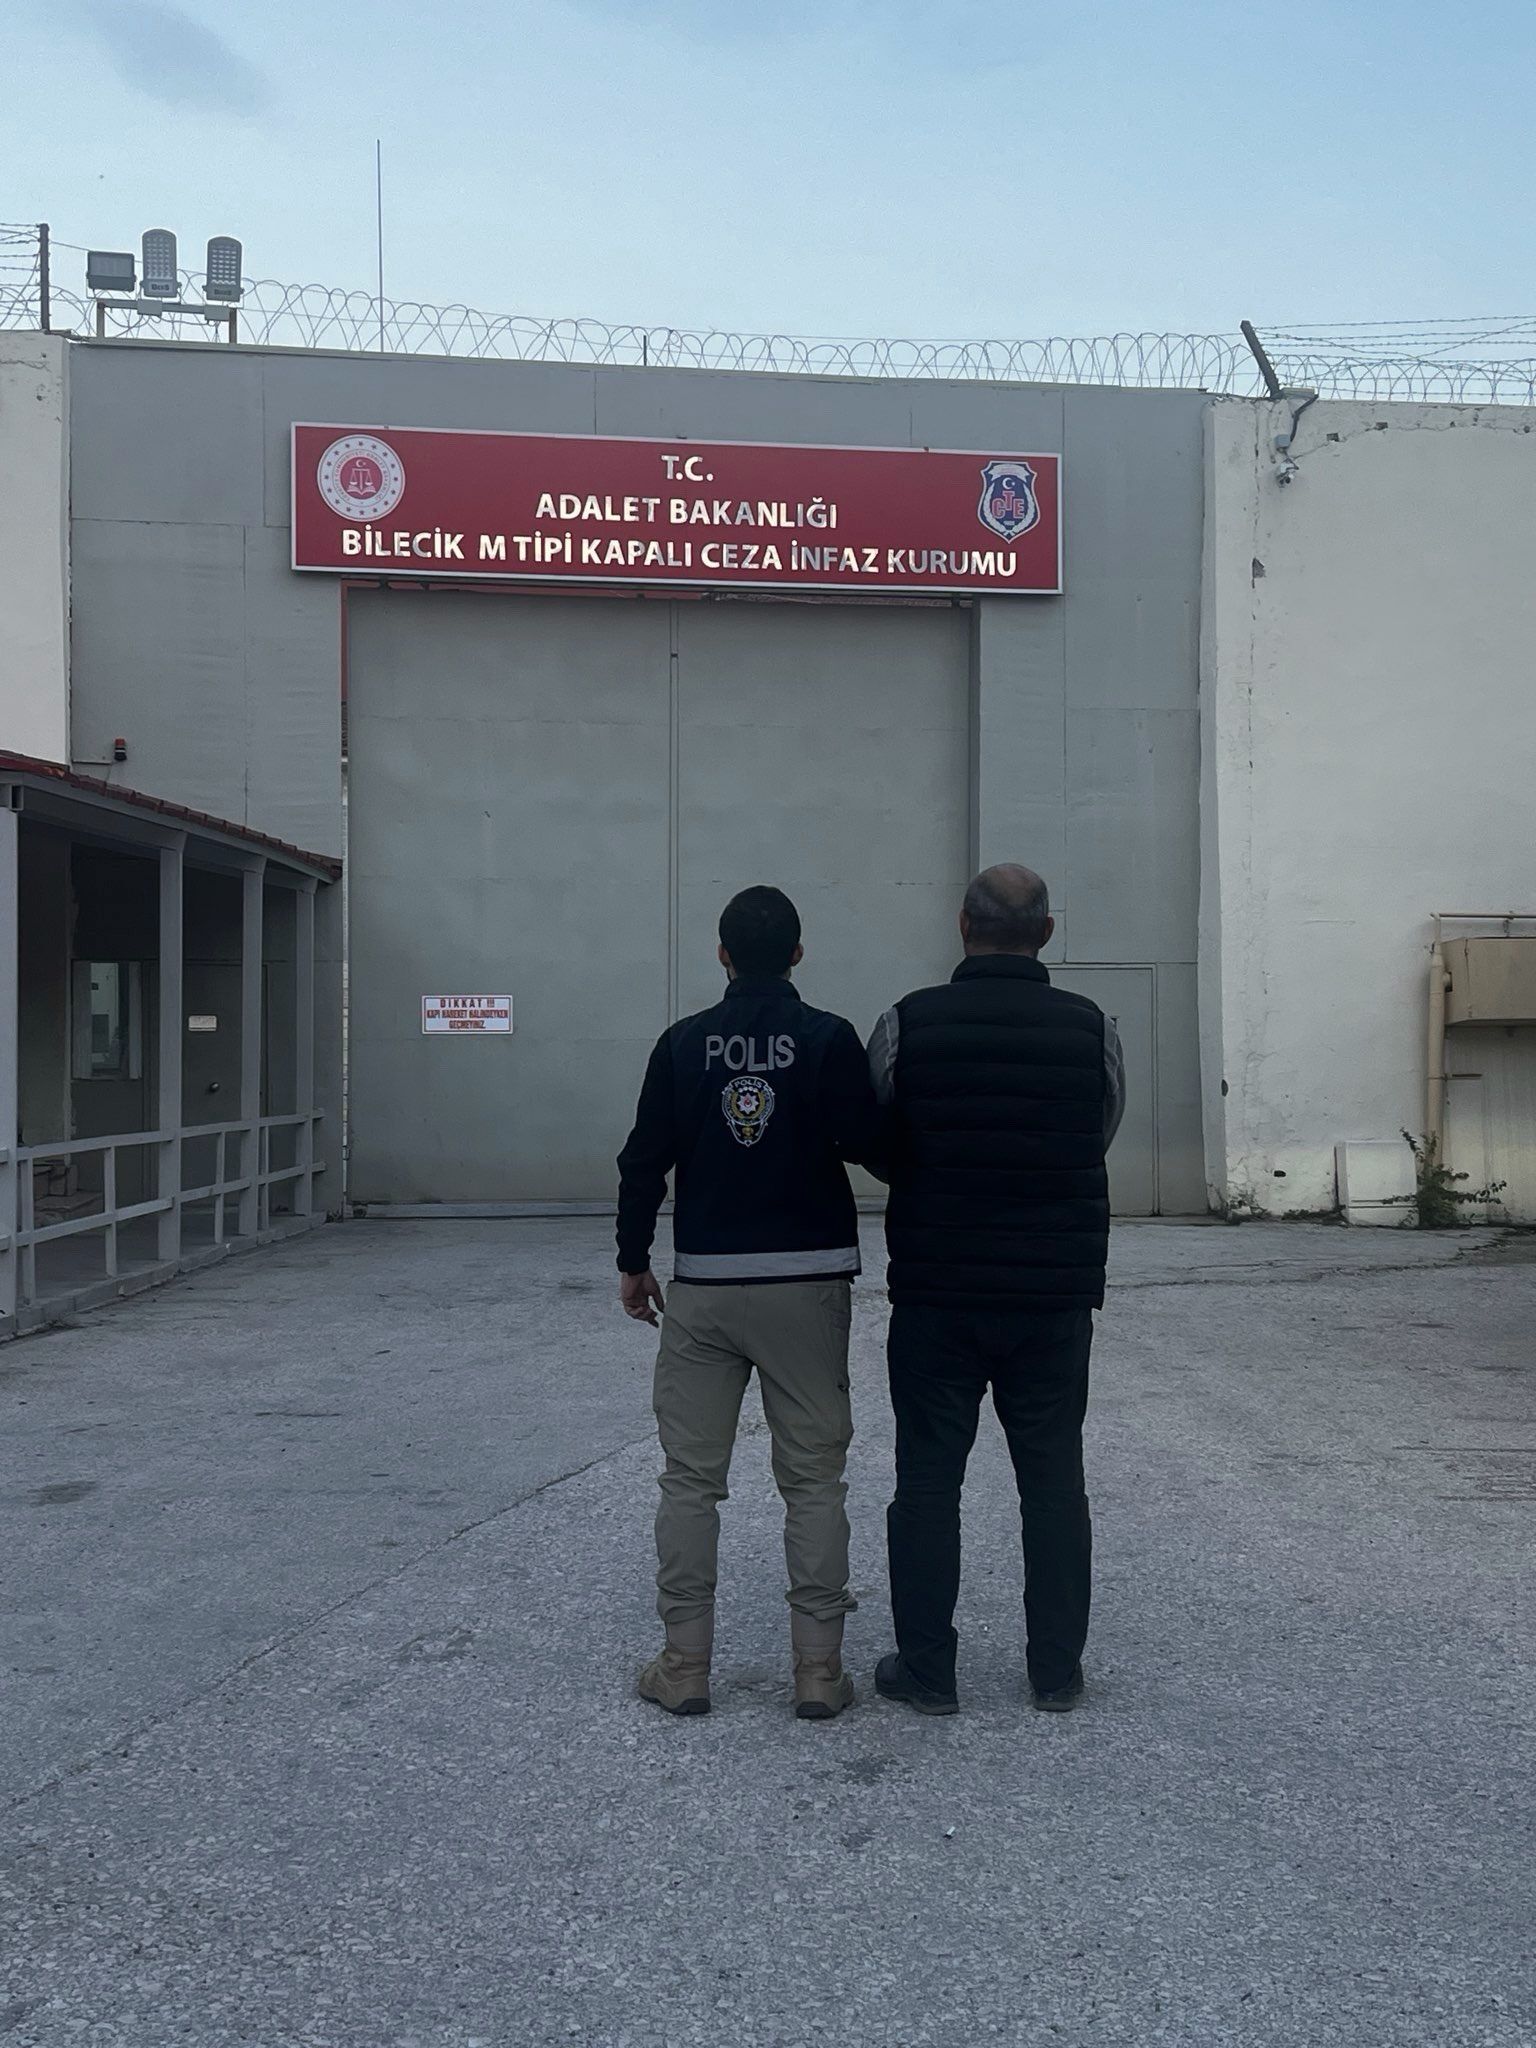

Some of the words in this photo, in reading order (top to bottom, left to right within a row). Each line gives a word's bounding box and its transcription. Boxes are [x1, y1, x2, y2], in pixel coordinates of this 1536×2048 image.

[661, 455, 713, 481] T.C.
[536, 493, 660, 523] ADALET
[669, 497, 837, 529] BAKANLIĞI
[342, 524, 465, 560] BİLECİK
[479, 534, 506, 561] M
[513, 530, 573, 563] TİPİ
[581, 538, 692, 567] KAPALI
[701, 542, 782, 570] CEZA
[791, 540, 879, 573] İNFAZ
[887, 548, 1017, 577] KURUMU
